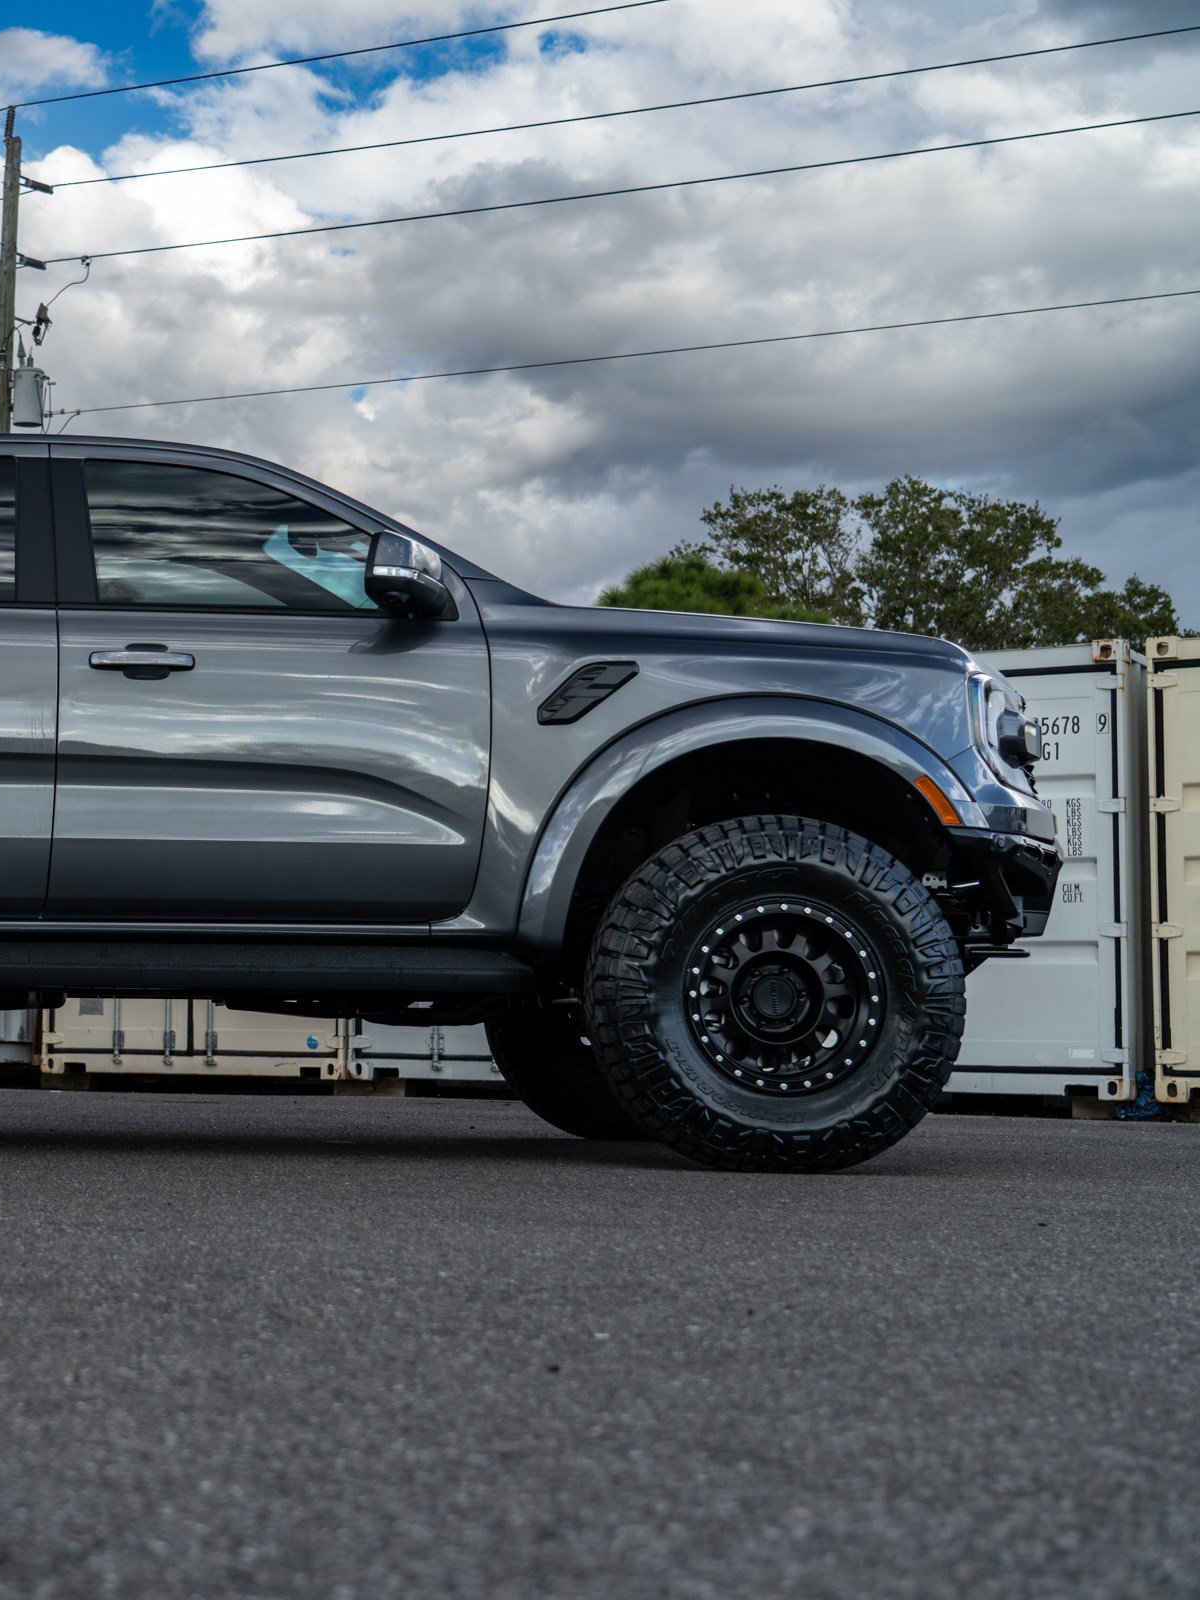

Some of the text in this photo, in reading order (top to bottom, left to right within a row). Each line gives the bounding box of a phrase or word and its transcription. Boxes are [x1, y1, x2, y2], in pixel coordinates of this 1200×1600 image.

[1033, 714, 1107, 735] 5678 9
[1066, 798, 1081, 808] KGS
[1066, 808, 1082, 818] LBS
[1066, 818, 1082, 828] KGS
[1066, 828, 1082, 837] LBS
[1067, 837, 1082, 847] KGS
[1067, 847, 1083, 857] LBS
